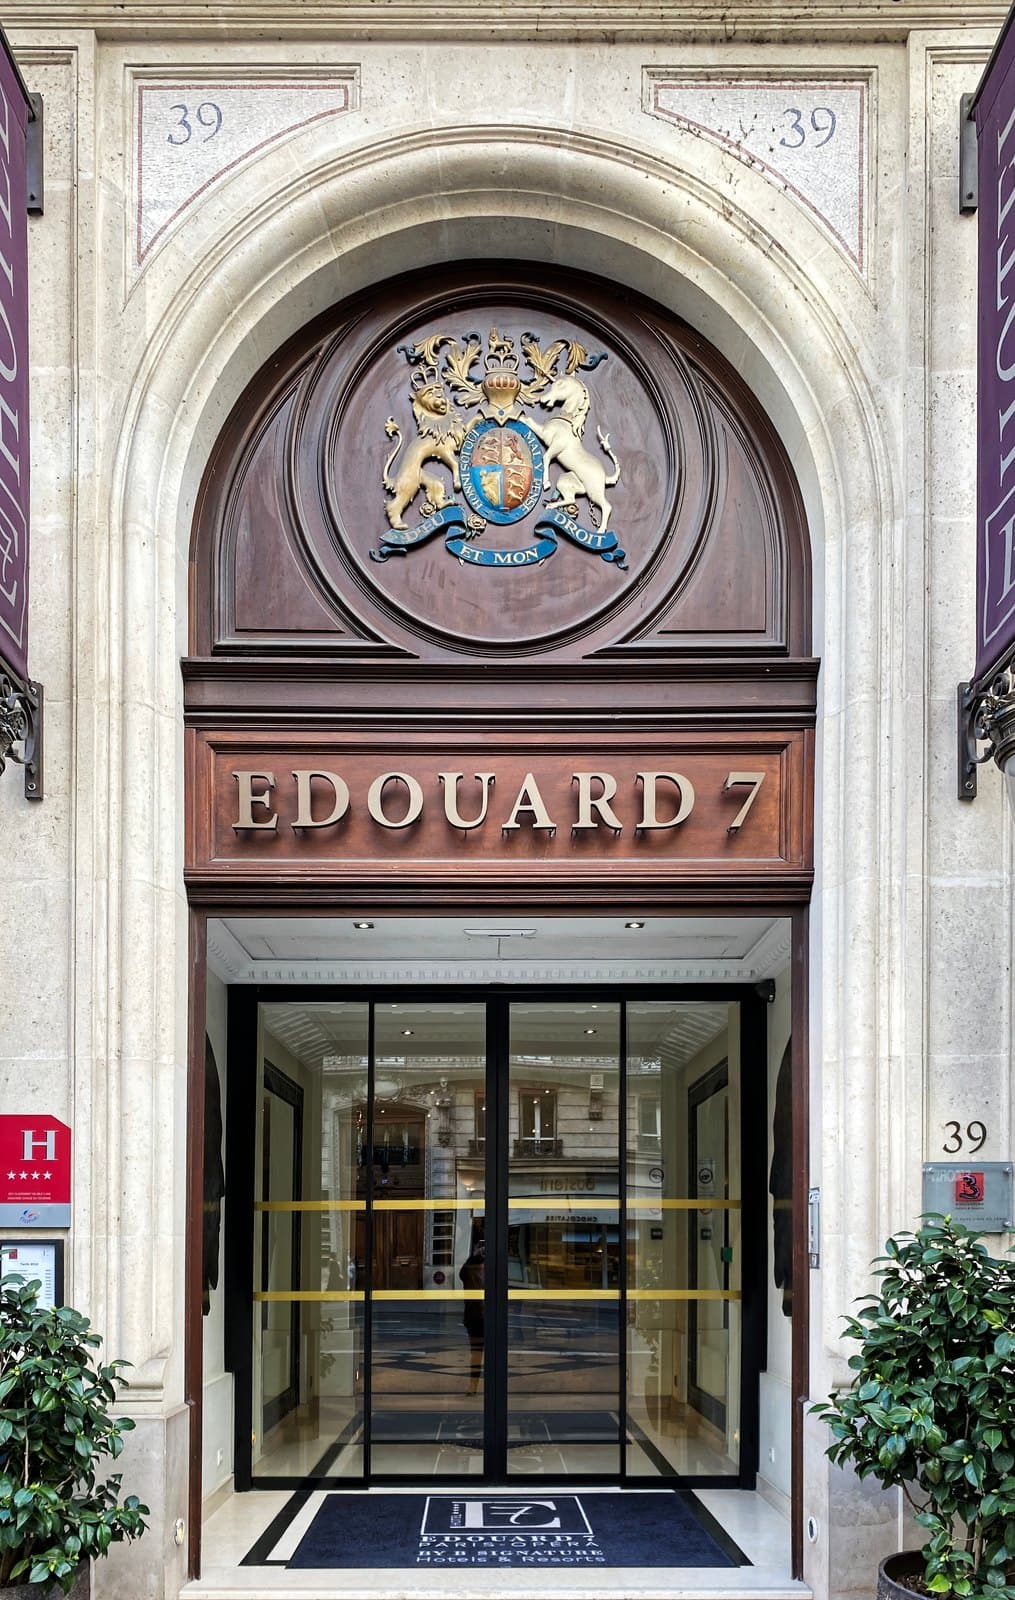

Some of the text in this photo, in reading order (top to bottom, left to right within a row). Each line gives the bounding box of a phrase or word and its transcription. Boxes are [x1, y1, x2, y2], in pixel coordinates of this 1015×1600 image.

[167, 103, 222, 145] 39
[780, 107, 836, 148] 39
[524, 431, 543, 461] MAL
[554, 513, 606, 547] DROIT
[460, 545, 539, 564] ET MON
[231, 770, 767, 831] EDOUARD 7
[19, 1129, 60, 1161] H
[943, 1120, 987, 1154] 39
